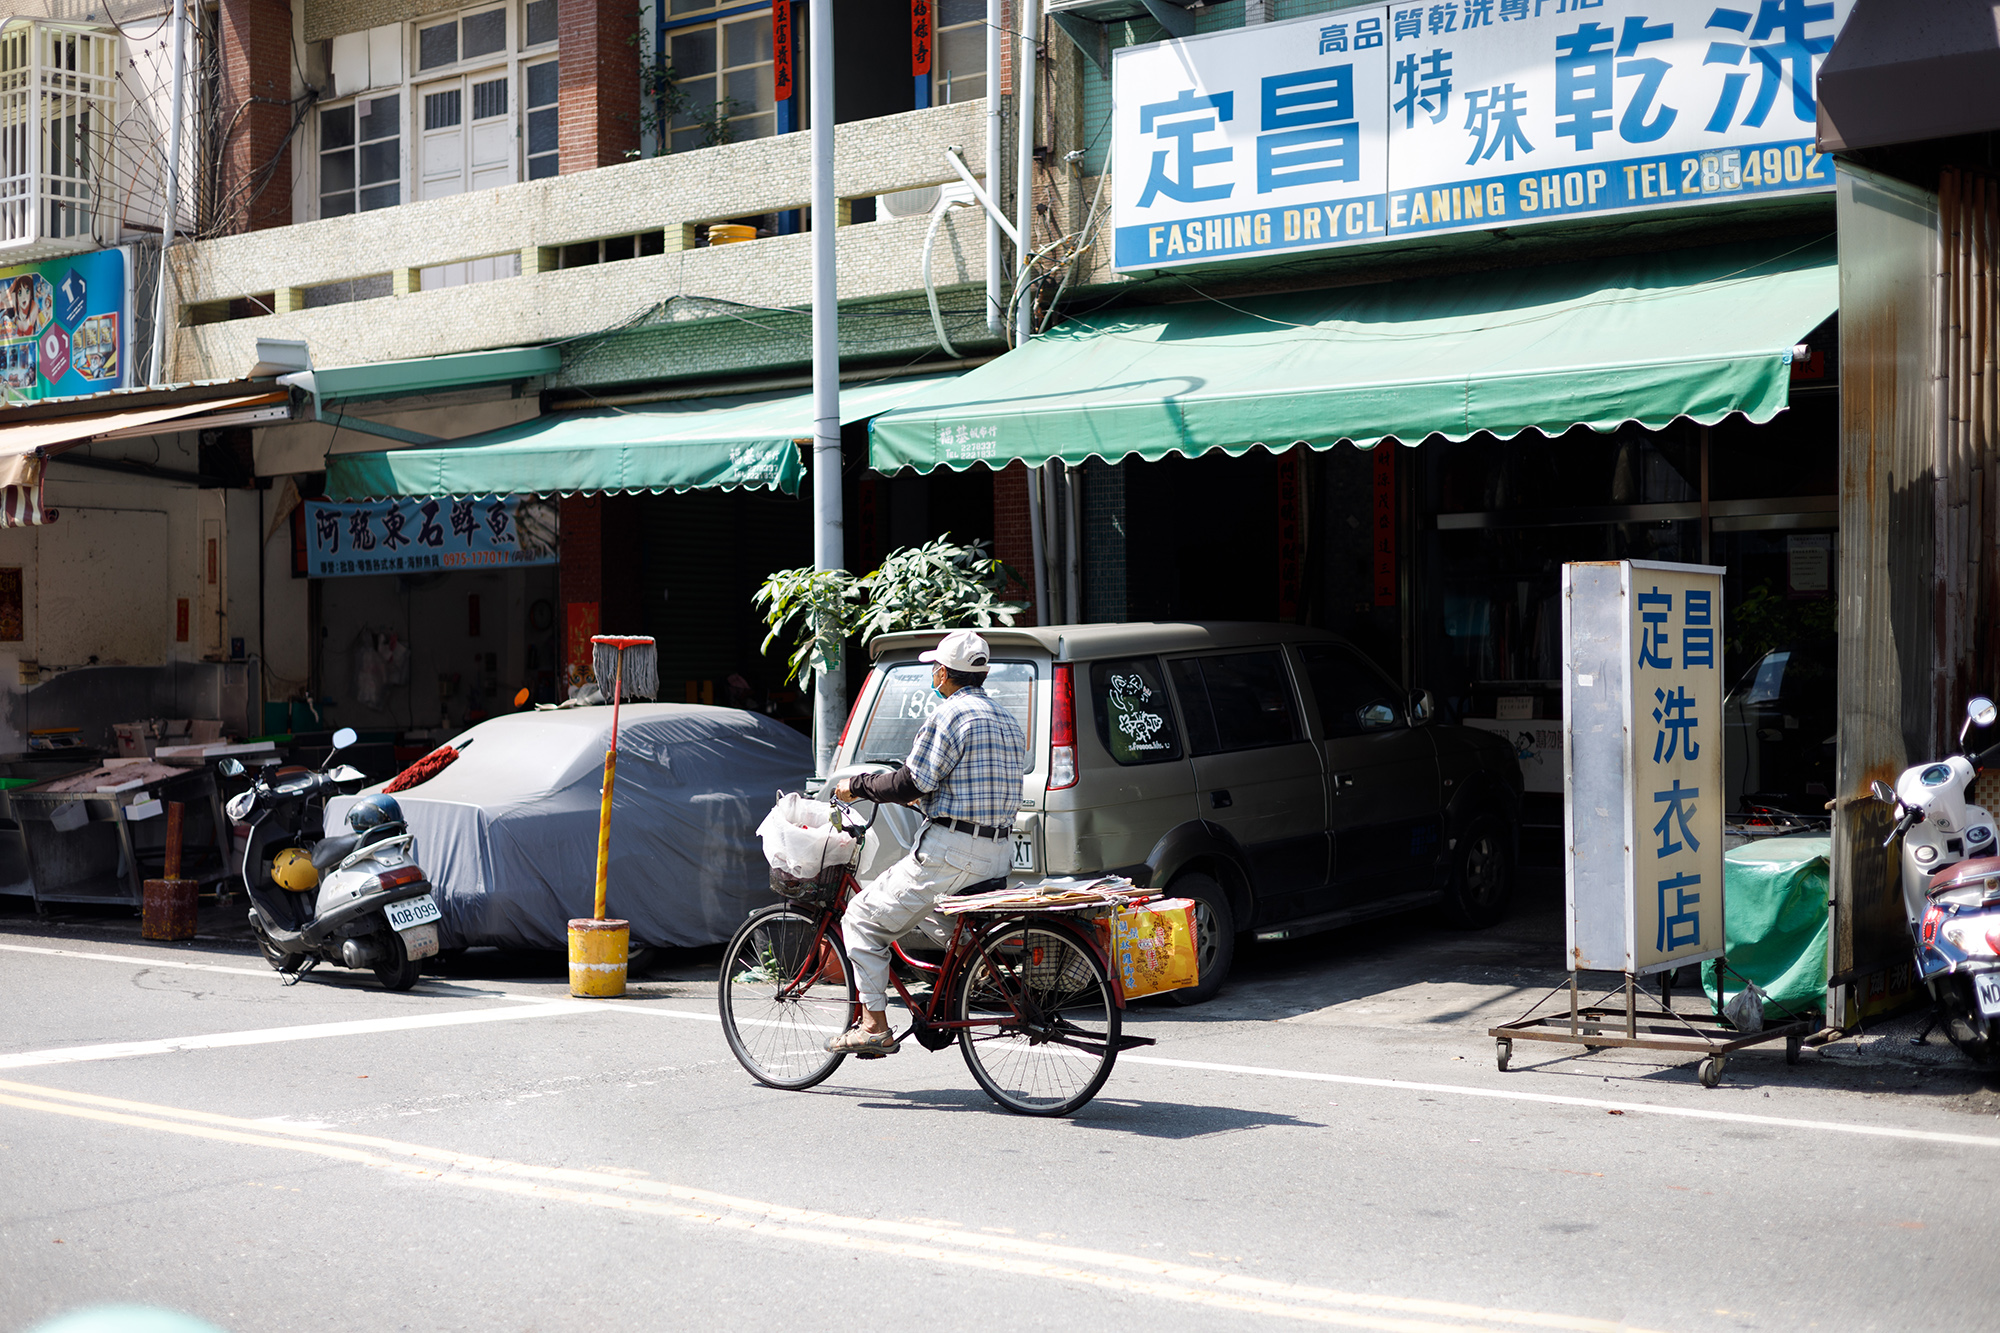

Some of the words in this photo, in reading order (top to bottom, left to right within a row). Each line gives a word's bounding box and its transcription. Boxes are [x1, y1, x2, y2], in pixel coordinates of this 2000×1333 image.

[1135, 63, 1361, 209] 定昌
[1555, 0, 1835, 152] 乾洗
[1148, 212, 1272, 258] FASHING
[1519, 169, 1607, 212] SHOP
[1623, 162, 1676, 201] TEL
[1682, 144, 1825, 195] 2854902
[315, 499, 516, 554] 阿龍東石鮮魚
[1637, 586, 1714, 670] 定昌
[1652, 685, 1702, 953] 洗衣店
